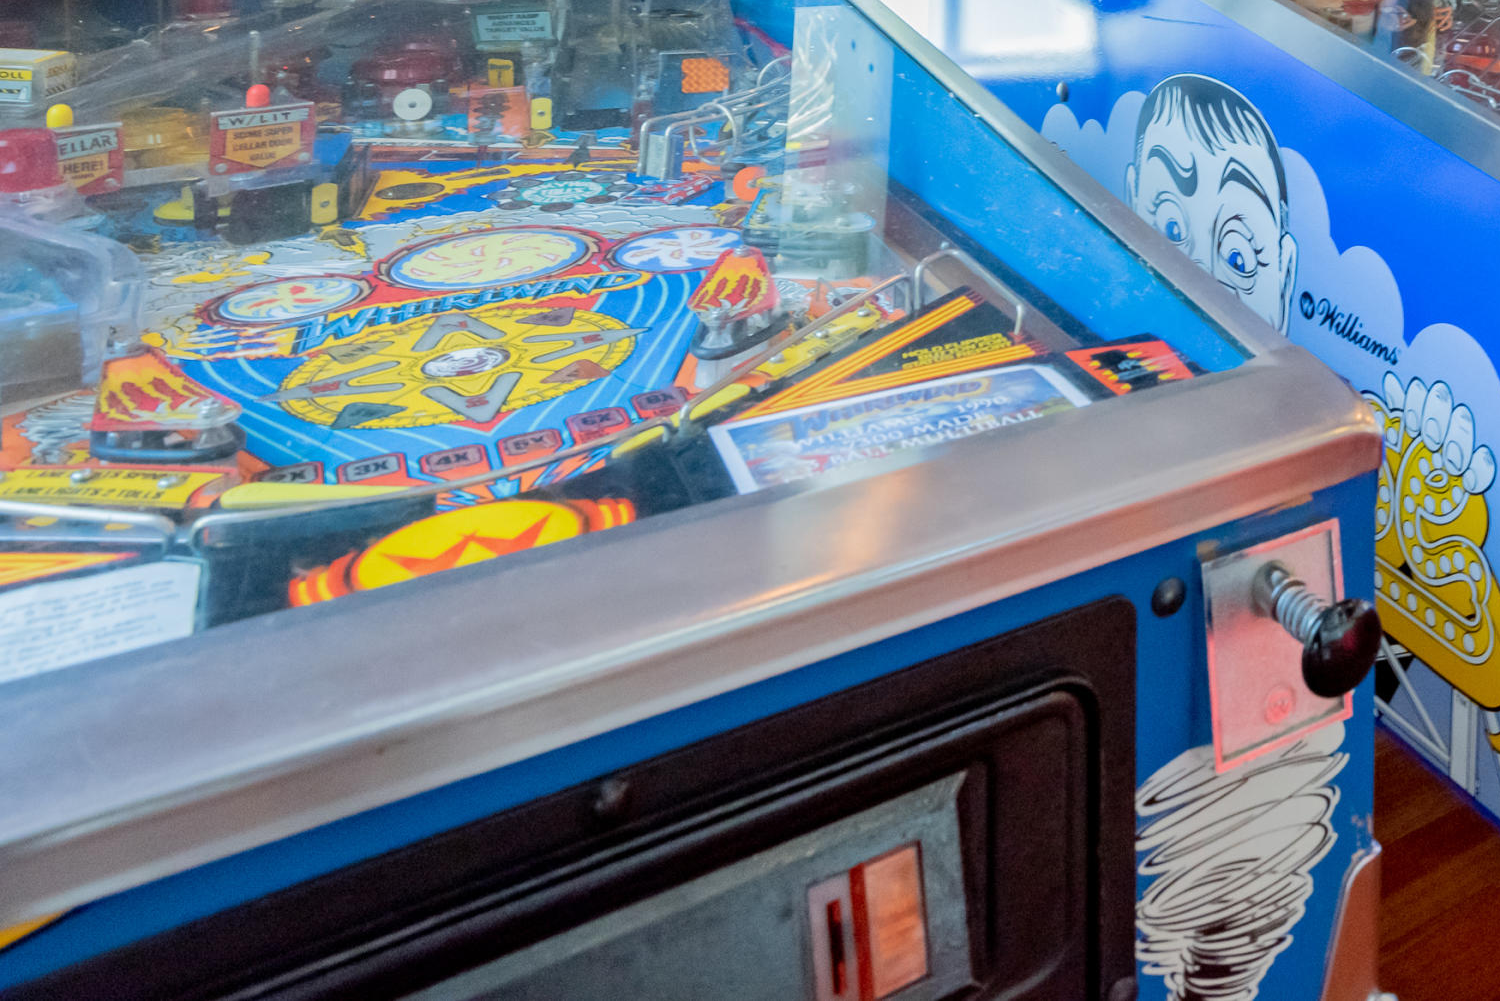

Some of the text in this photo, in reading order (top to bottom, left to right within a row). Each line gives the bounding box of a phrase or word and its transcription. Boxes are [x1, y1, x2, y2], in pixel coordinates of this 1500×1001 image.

[292, 271, 643, 355] WHIRLWIND
[1317, 297, 1401, 366] Williams
[581, 412, 611, 426] 6X
[790, 397, 1011, 448] WILLIAMS 1990
[900, 409, 1045, 449] MULTIBALL
[911, 412, 988, 435] MADE
[513, 435, 544, 451] 5X
[352, 460, 391, 479] 3X
[436, 451, 471, 467] 4X
